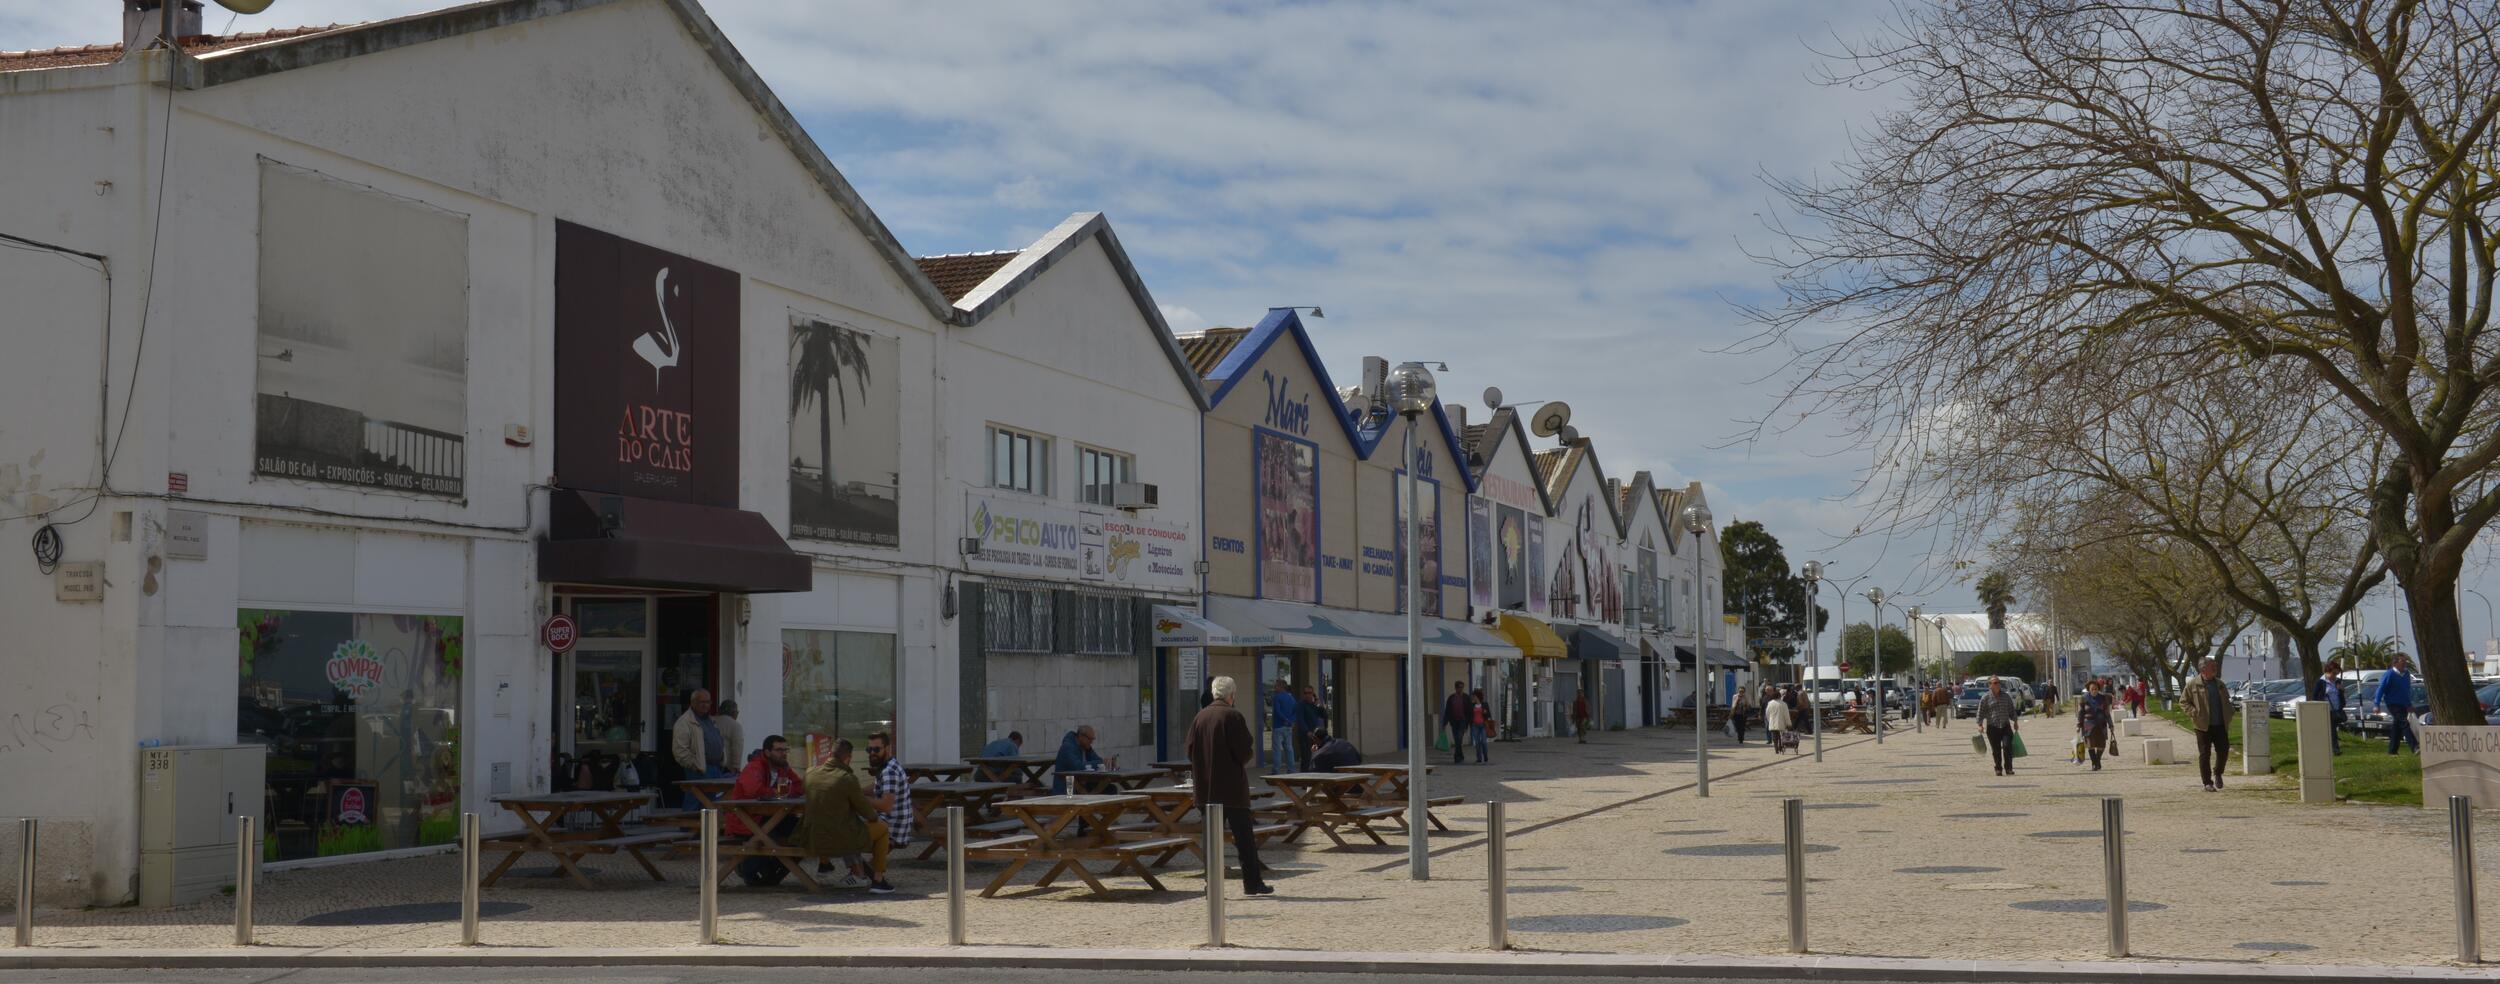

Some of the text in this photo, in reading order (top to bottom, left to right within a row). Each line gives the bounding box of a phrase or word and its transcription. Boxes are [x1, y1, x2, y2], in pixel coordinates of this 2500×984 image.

[1263, 369, 1309, 436] Maré
[618, 403, 692, 446] ARTE
[648, 442, 691, 472] CAIS
[258, 457, 286, 474] SALÃO
[288, 461, 299, 475] DE
[327, 466, 375, 485] EXPOSIÇÕES
[384, 472, 413, 489] SNACKS
[421, 476, 461, 495] GELADARIA
[993, 515, 1077, 551] PSICOAUTO
[1136, 527, 1147, 535] DE
[1147, 528, 1186, 541] CONDUÇÃO
[1213, 536, 1245, 554] EVENTOS
[1152, 562, 1184, 576] Motociclos
[1322, 555, 1354, 571] TAKE-AWAY
[1362, 562, 1394, 577] NO CARVÃO
[550, 626, 570, 634] SUPER
[550, 633, 570, 641] BOCK
[2425, 731, 2469, 753] PASSEIO
[2471, 731, 2484, 753] do
[150, 759, 169, 770] 338
